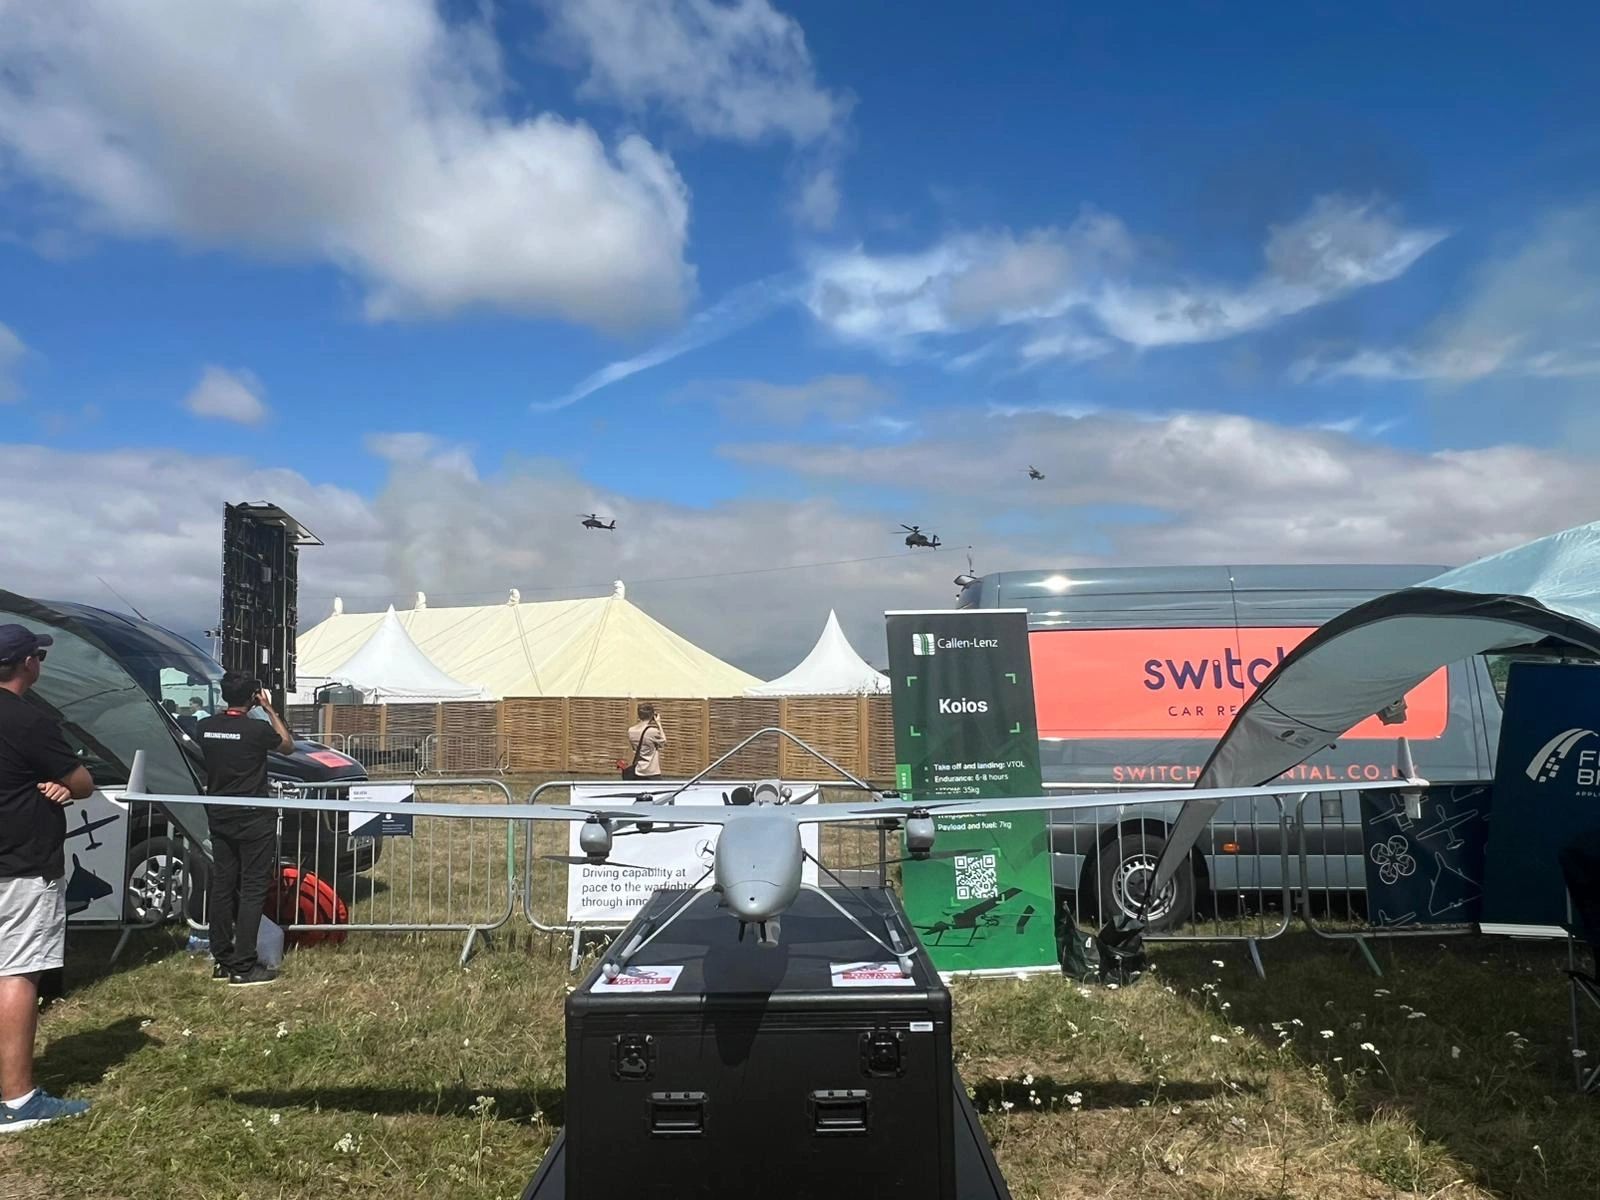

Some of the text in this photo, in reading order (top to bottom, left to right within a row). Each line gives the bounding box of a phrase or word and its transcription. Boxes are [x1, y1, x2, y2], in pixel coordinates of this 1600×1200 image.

[937, 637, 998, 649] Callen-Lenz
[938, 697, 988, 714] Koios
[1168, 705, 1241, 717] CAR RE
[934, 760, 1026, 771] Take off and landing: VTOL
[934, 773, 1009, 783] Endurance: 6-8 hours
[963, 786, 980, 795] 35kg
[938, 820, 1012, 832] Payload and fuel: 7kg
[582, 867, 686, 880] Driving capability at
[582, 881, 695, 895] pace to the warfighte
[581, 897, 648, 909] through inno
